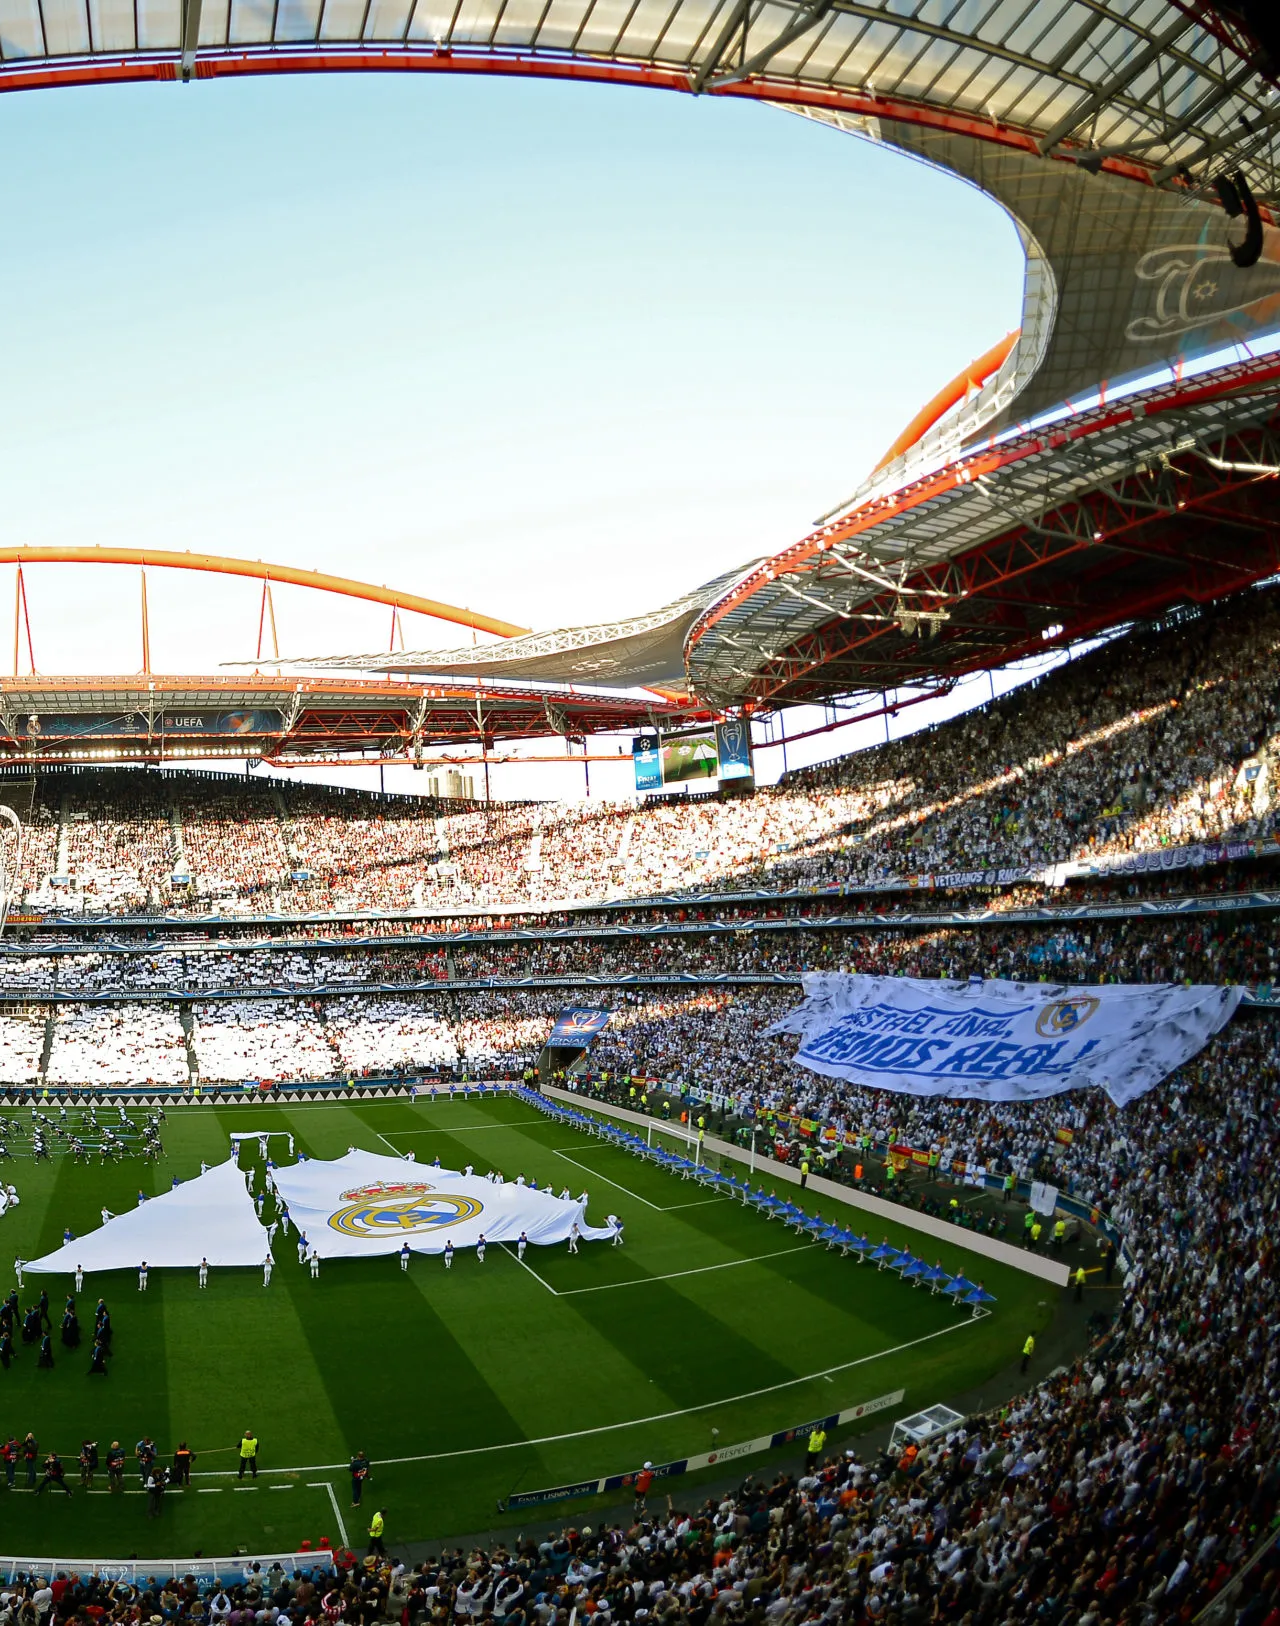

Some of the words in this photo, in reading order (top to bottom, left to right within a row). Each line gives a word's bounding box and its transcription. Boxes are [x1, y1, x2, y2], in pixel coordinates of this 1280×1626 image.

[175, 718, 203, 727] UEFA
[934, 870, 984, 888] VETERANOS
[931, 1013, 1014, 1040] FINAL,
[864, 1397, 893, 1414] RESPECT
[718, 1444, 752, 1460] RESPECT
[518, 1496, 539, 1504] FINAL
[543, 1488, 571, 1501] LISBON
[572, 1486, 590, 1496] 2014
